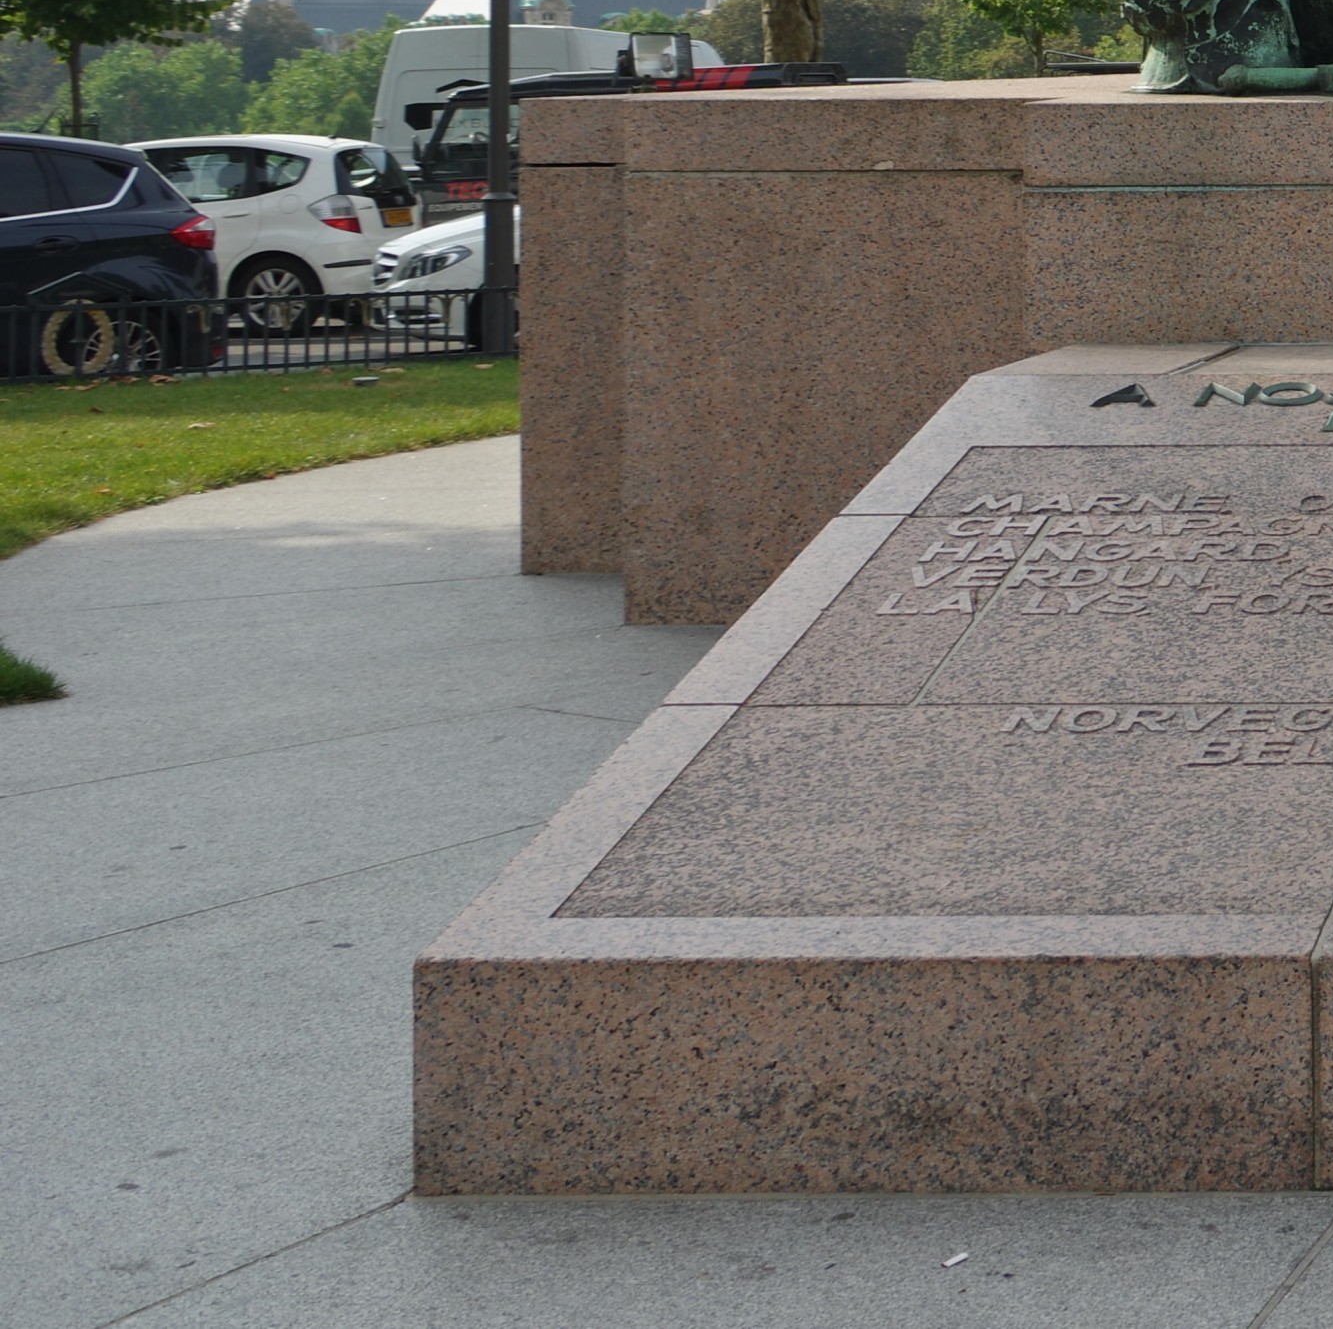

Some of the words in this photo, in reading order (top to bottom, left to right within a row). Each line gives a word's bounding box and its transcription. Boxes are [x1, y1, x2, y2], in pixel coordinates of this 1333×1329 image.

[1090, 382, 1156, 408] A
[917, 541, 1296, 564] HANGARD,
[910, 566, 1214, 590] VERDUN,
[875, 592, 975, 617] LA
